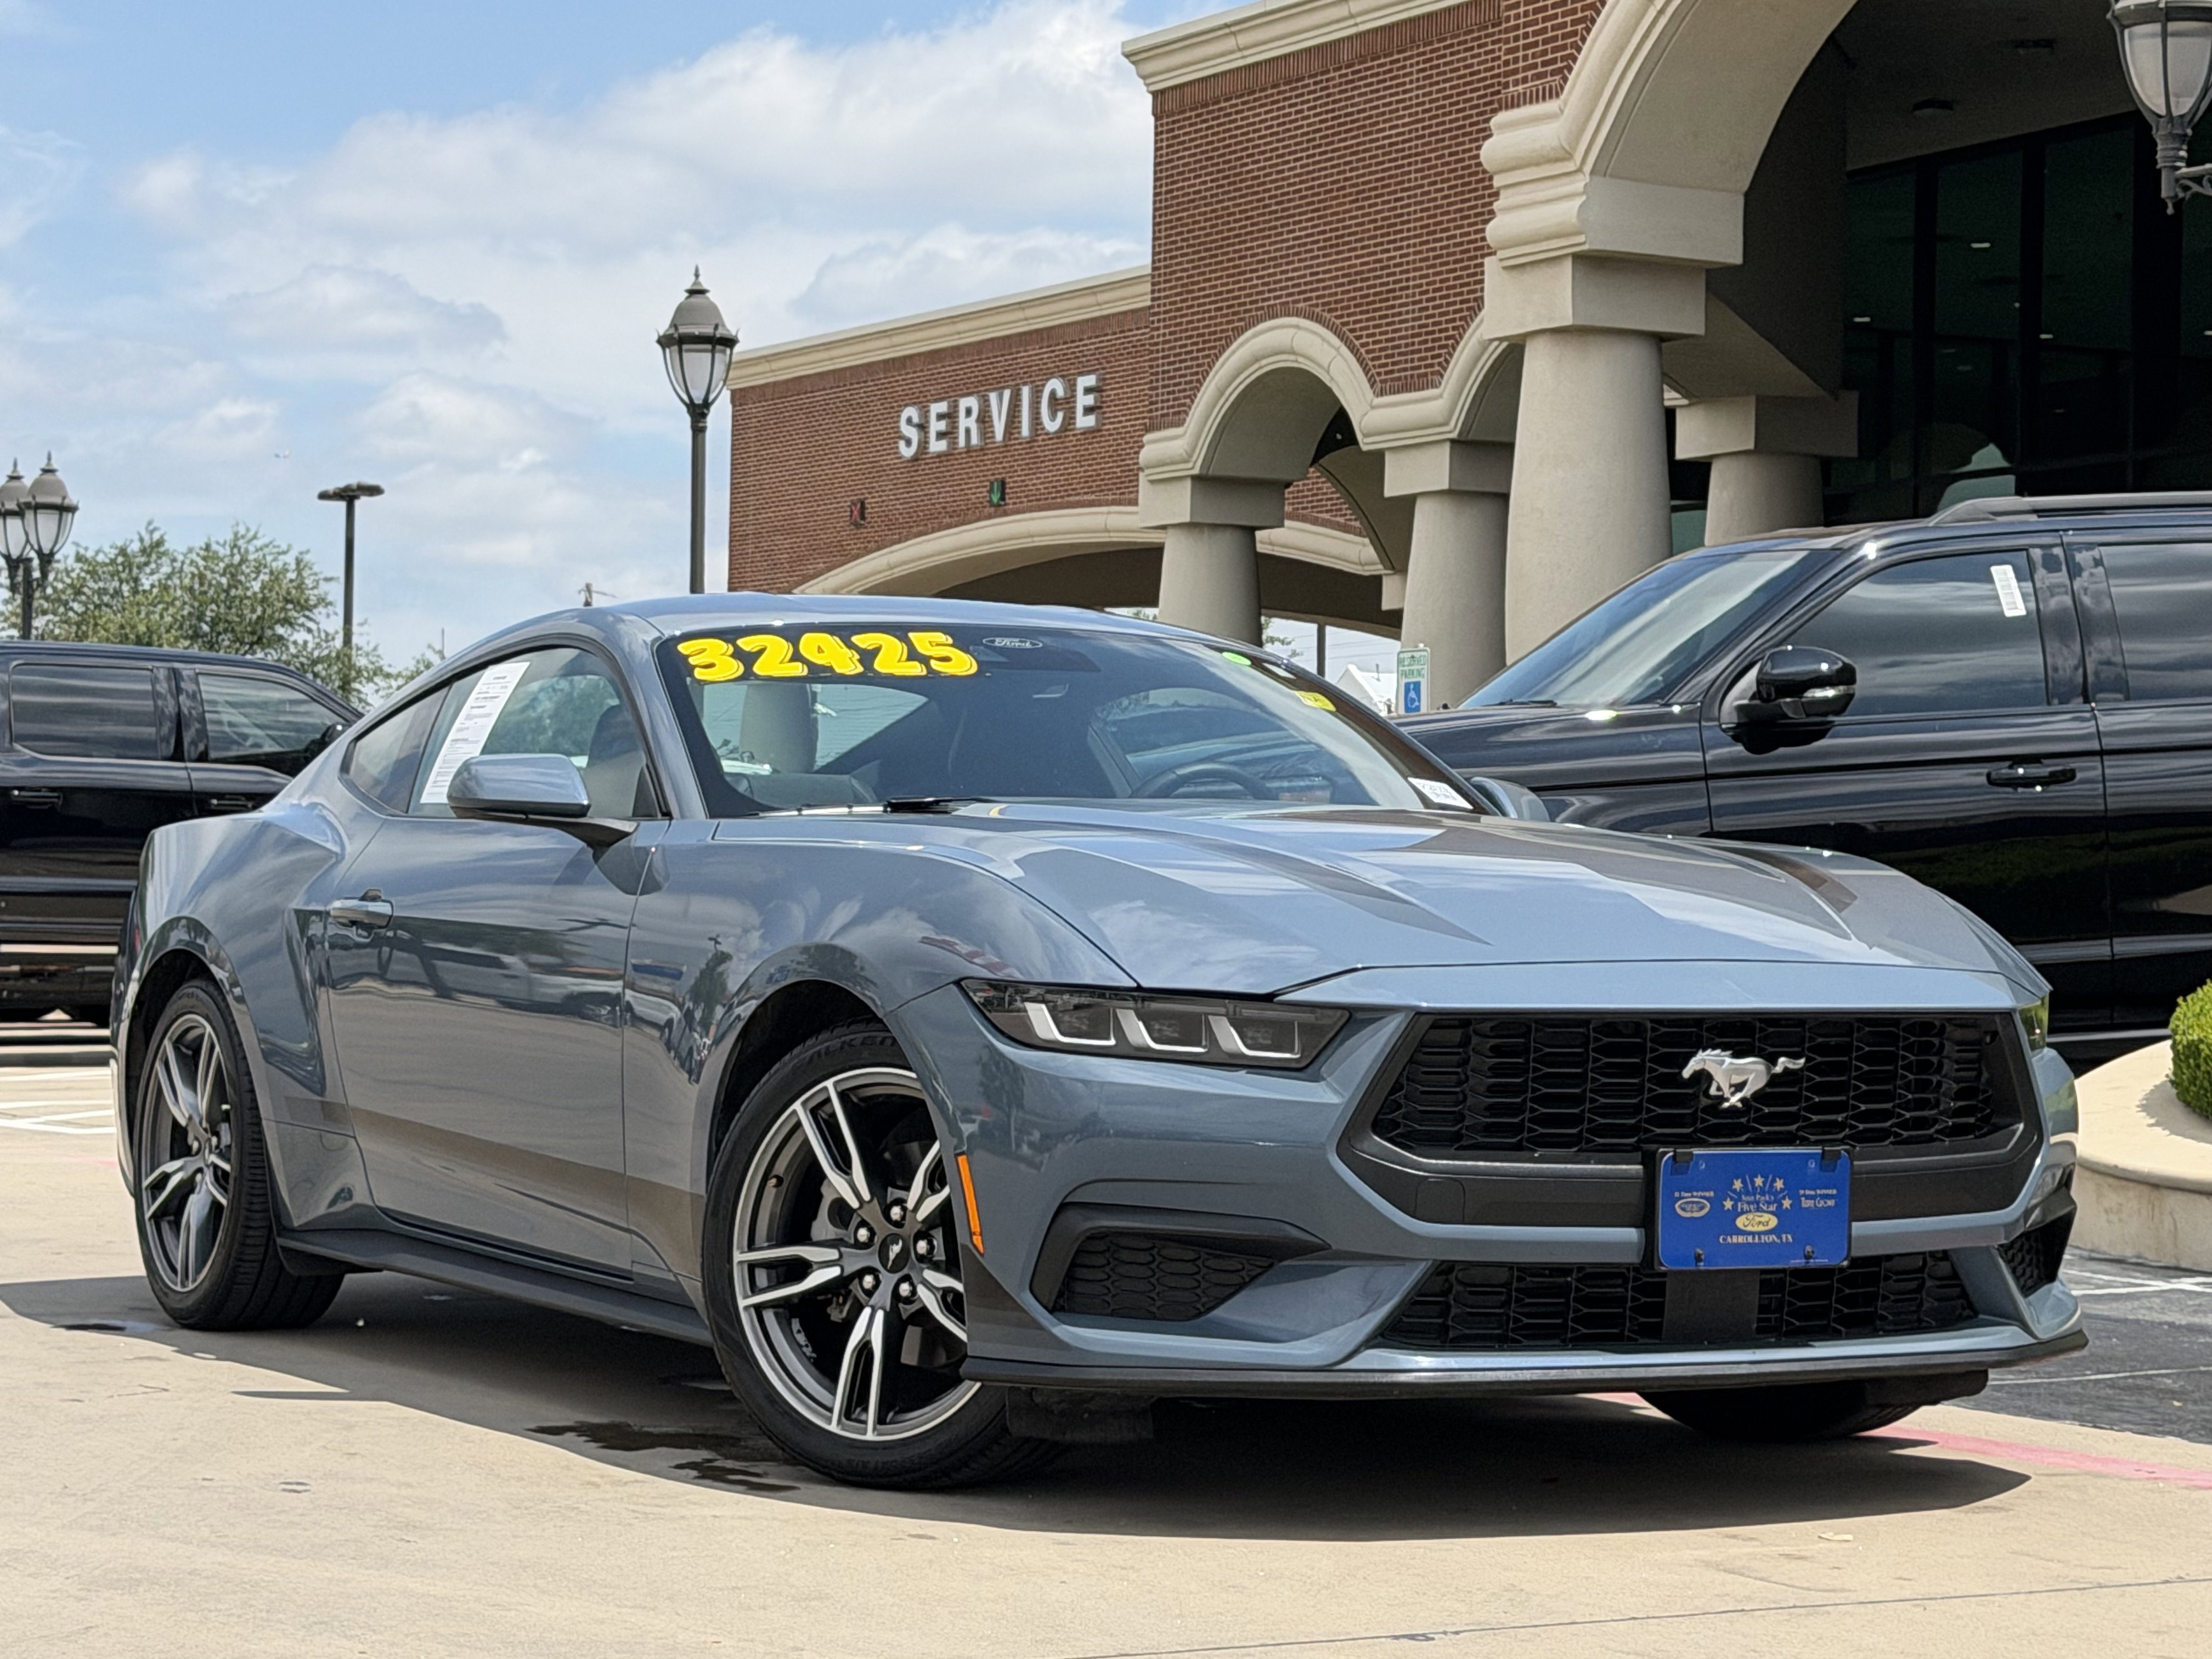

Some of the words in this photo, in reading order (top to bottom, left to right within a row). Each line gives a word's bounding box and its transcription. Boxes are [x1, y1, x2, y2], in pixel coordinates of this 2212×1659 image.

[898, 373, 1103, 459] SERVICE
[677, 632, 978, 681] 32425
[1400, 667, 1425, 679] PARKING
[1759, 1201, 1778, 1211] Star
[1742, 1214, 1771, 1228] Ford
[1781, 1233, 1793, 1243] TX
